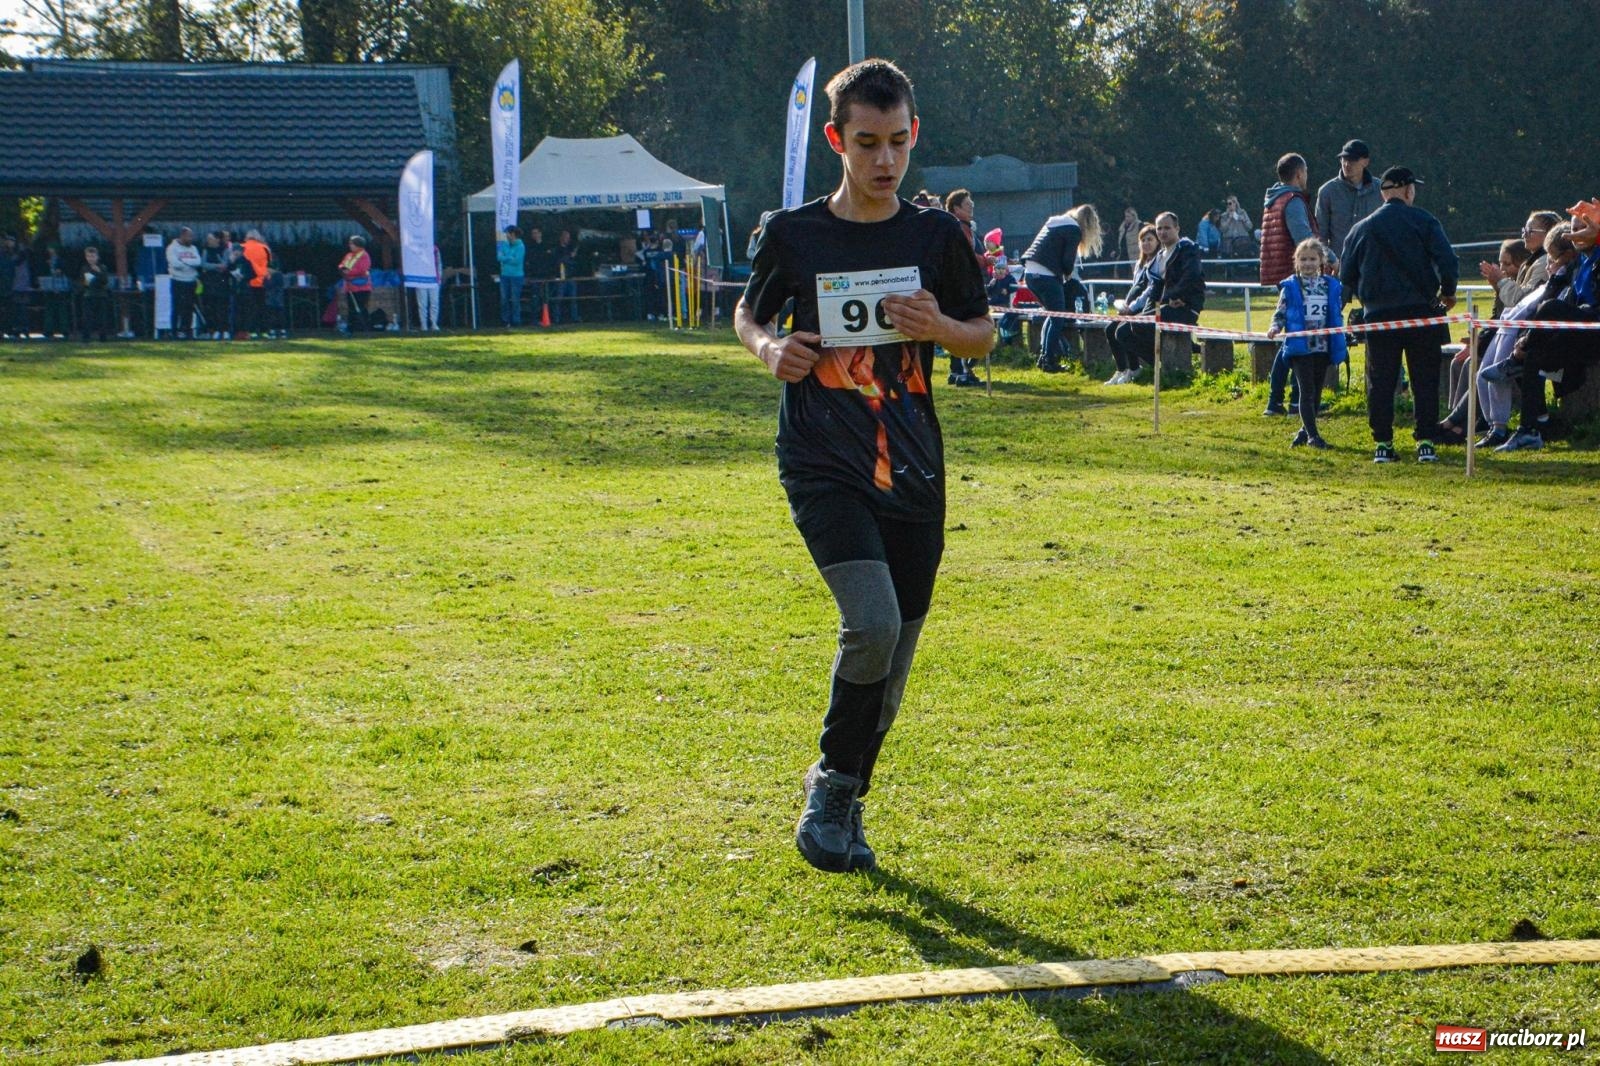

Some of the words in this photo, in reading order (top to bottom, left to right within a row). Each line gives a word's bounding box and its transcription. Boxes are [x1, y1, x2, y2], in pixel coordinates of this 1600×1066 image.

[518, 195, 567, 207] OWARZYSZENIE
[607, 193, 620, 204] DLA
[625, 192, 657, 203] LEPSZEGO
[663, 191, 683, 201] JUTRA
[854, 275, 917, 287] www.personalbest.pl
